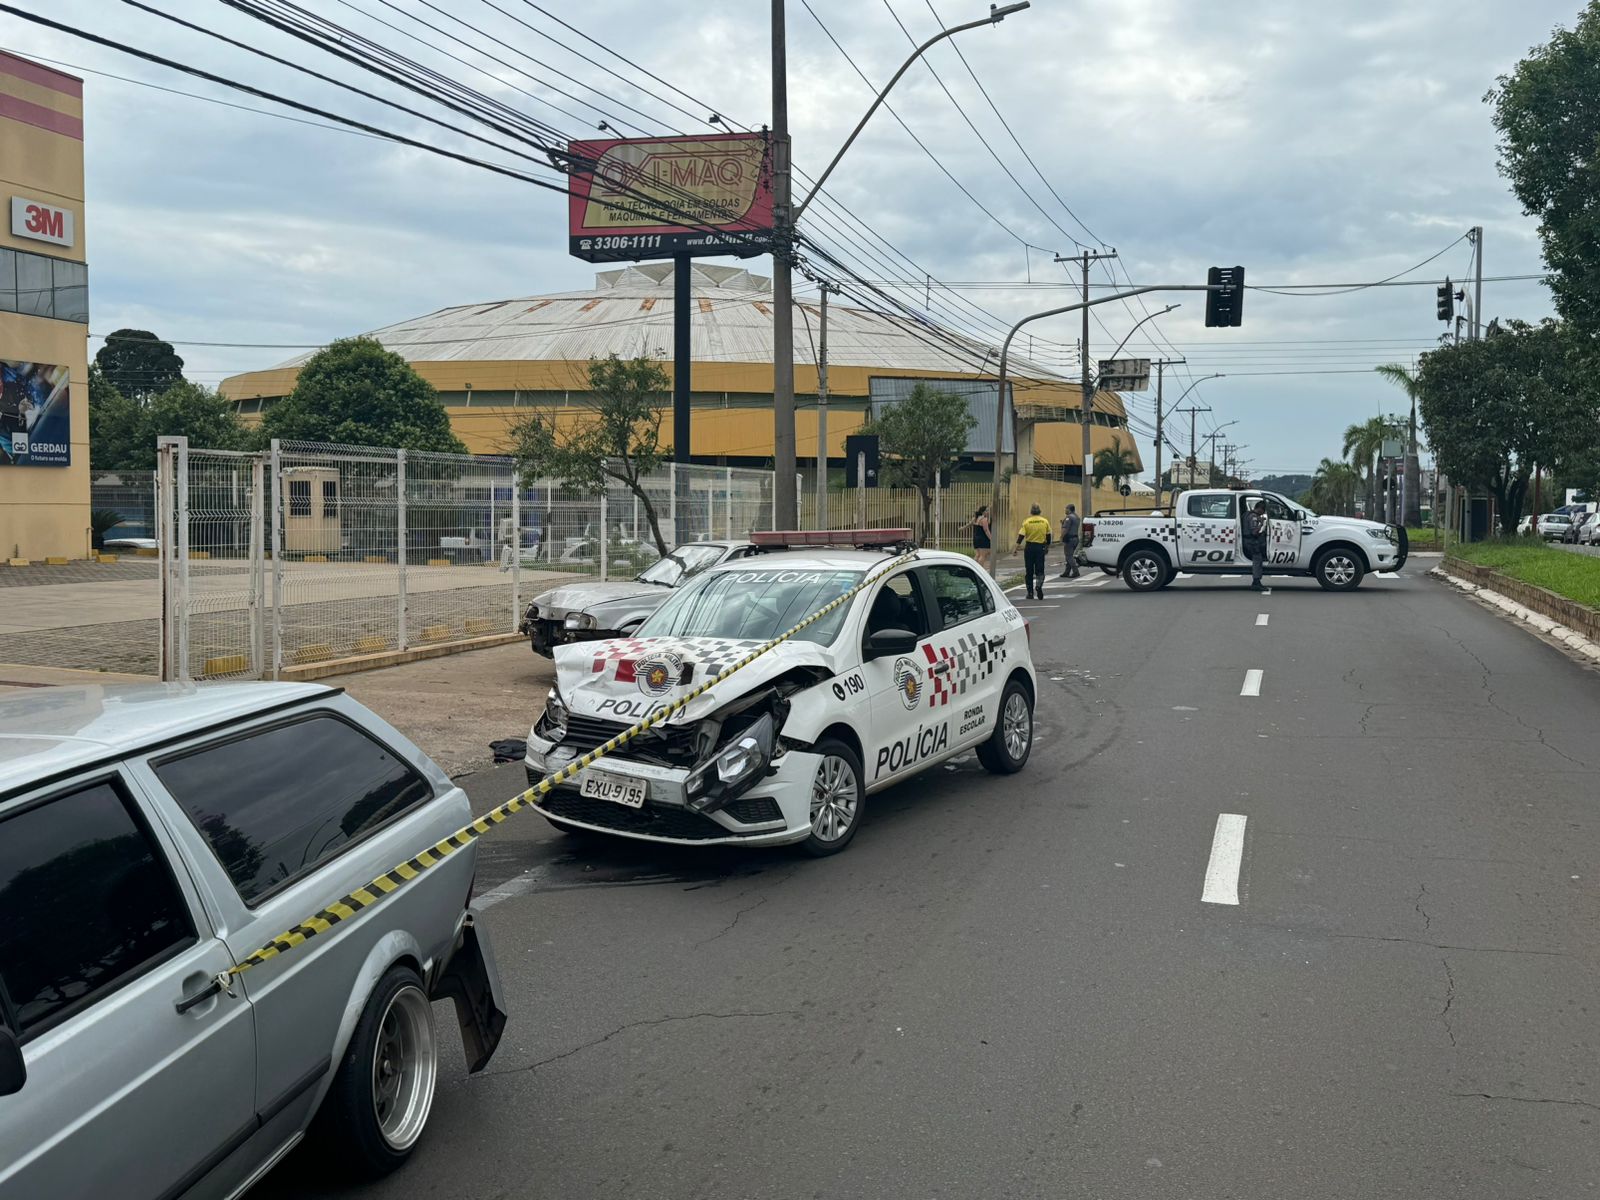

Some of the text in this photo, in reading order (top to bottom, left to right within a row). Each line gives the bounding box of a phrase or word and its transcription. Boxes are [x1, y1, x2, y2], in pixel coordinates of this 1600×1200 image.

[25, 205, 63, 238] 3M
[594, 235, 661, 249] 3306-1111
[31, 443, 67, 453] GERDAU
[718, 570, 821, 585] POLÍCIA
[843, 673, 864, 696] 190
[964, 704, 984, 721] RONDA
[959, 715, 986, 736] ESCOLAR
[875, 722, 948, 780] POLÍCIA
